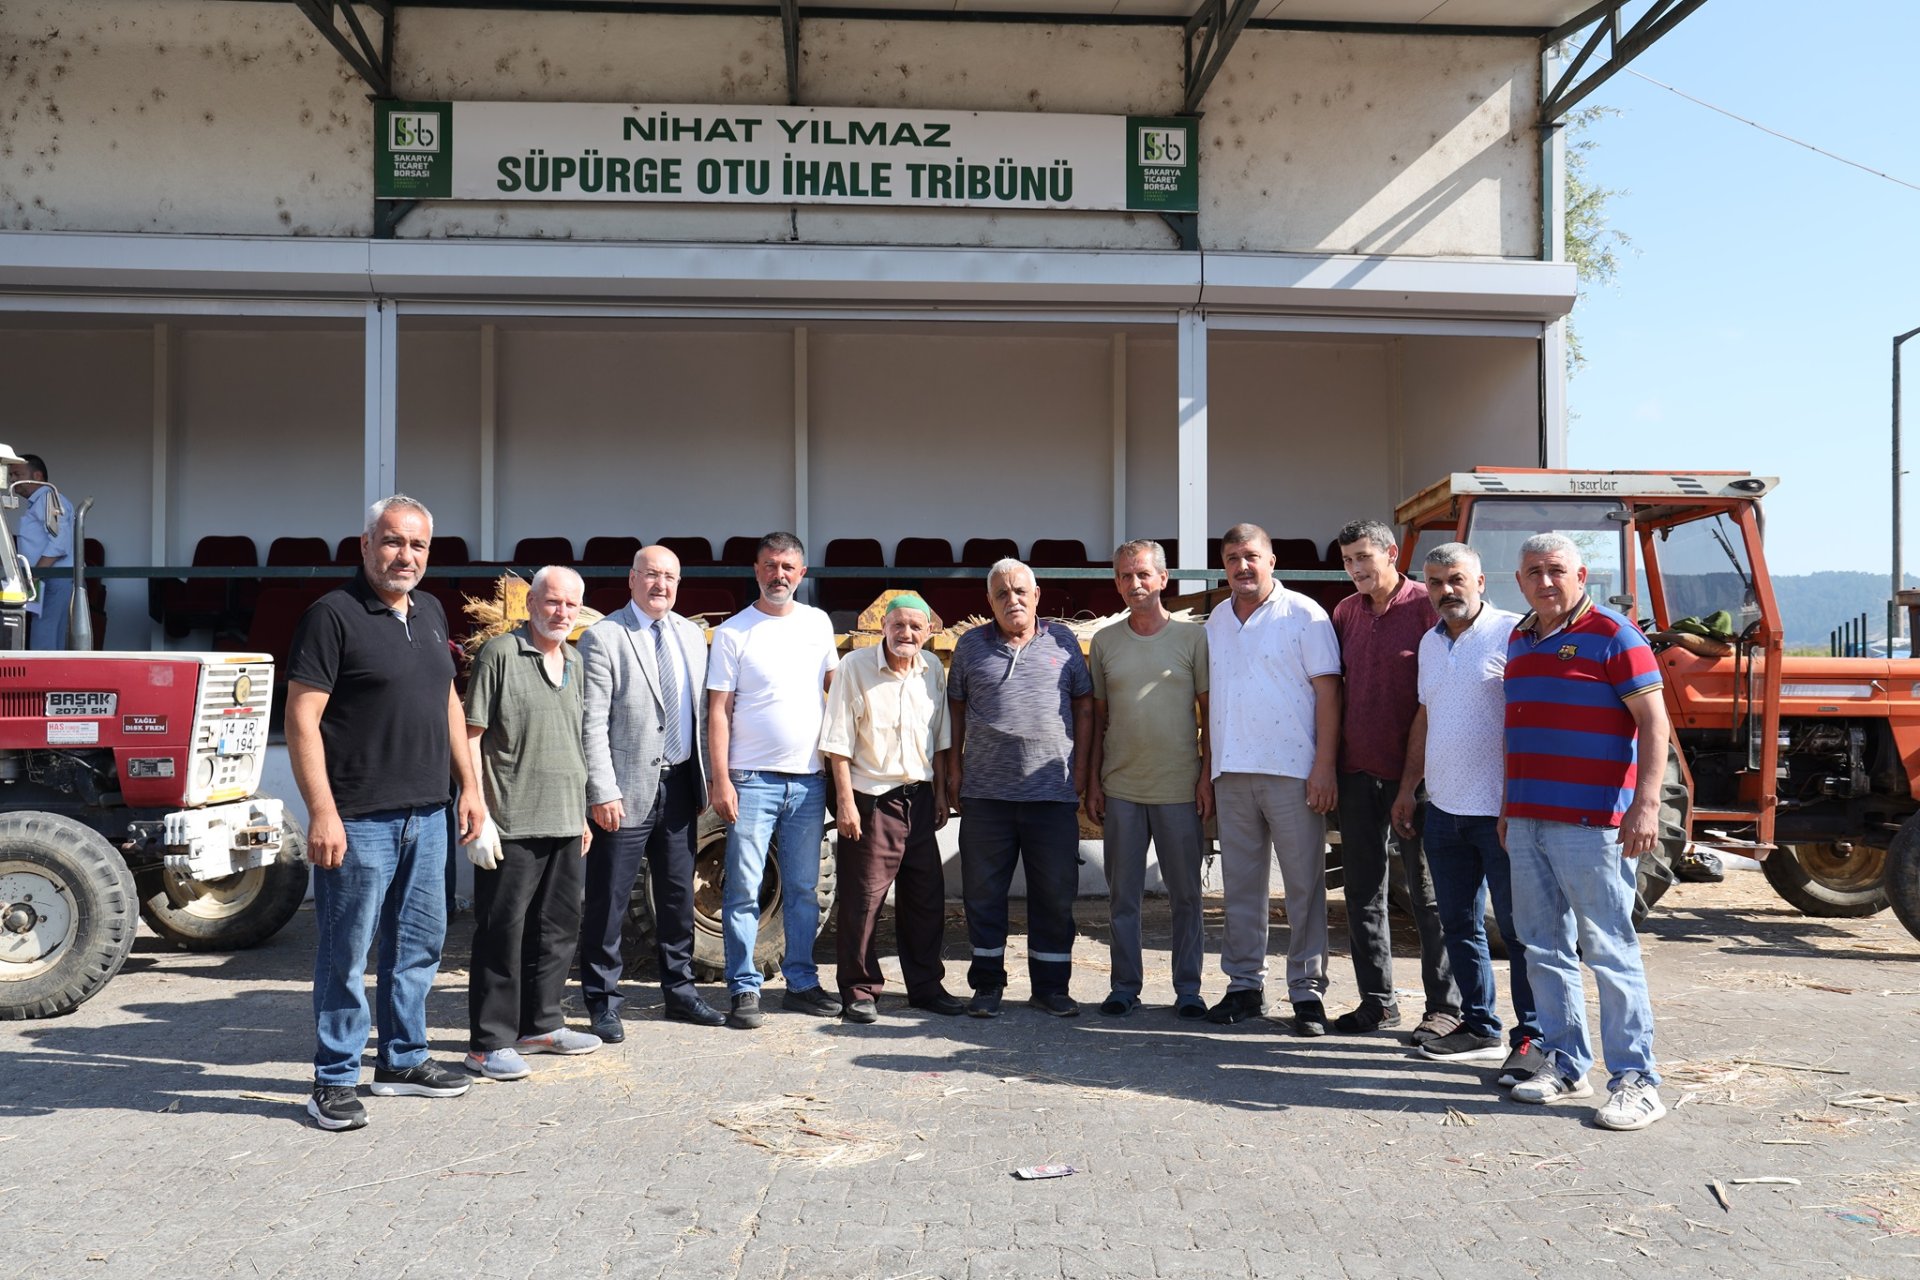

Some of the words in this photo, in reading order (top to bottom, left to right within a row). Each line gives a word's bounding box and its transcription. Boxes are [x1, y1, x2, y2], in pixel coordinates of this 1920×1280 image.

[624, 111, 763, 143] NİHAT
[777, 119, 951, 148] YILMAZ
[393, 154, 434, 163] SAKARYA
[393, 169, 430, 178] BORSASI
[497, 149, 682, 194] SÜPÜRGE
[698, 158, 770, 196] OTU
[783, 152, 892, 198] İHALE
[906, 156, 1073, 203] TRİBÜNÜ
[1143, 168, 1182, 177] SAKARYA
[1143, 183, 1178, 192] BORSASI
[50, 693, 110, 707] BAŞAK
[55, 707, 87, 715] 2073
[91, 707, 108, 715] SH
[144, 724, 166, 732] FREN
[225, 722, 236, 735] 14
[242, 722, 256, 736] AR
[236, 738, 253, 752] 194
